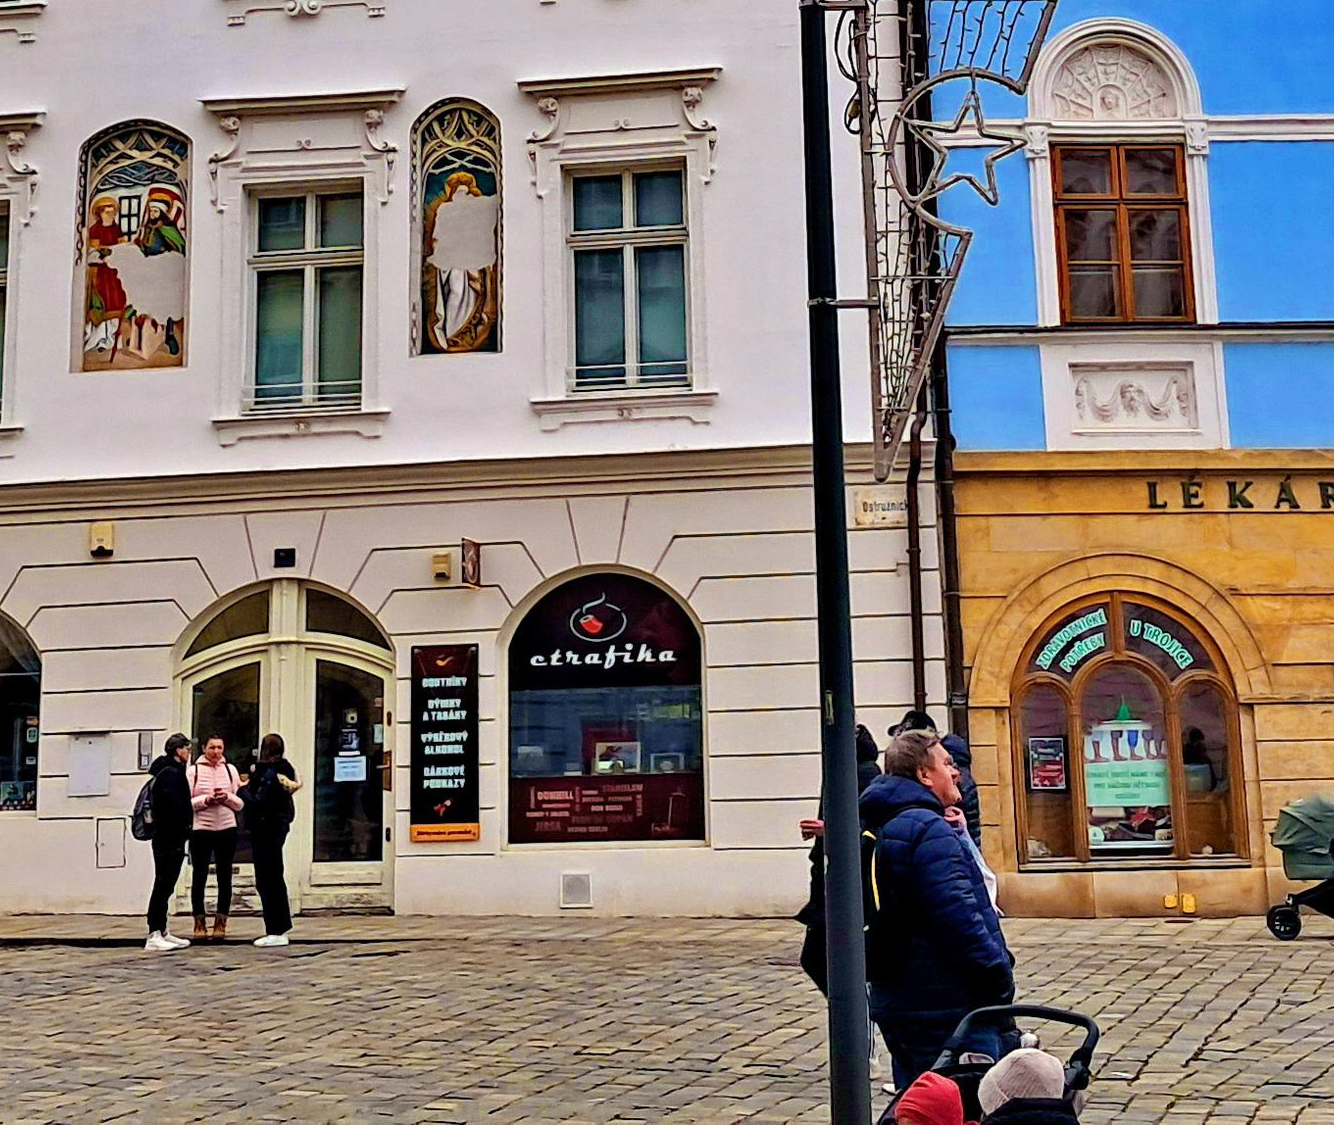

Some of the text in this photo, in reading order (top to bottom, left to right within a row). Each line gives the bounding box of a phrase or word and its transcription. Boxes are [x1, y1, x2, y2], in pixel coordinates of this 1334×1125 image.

[1035, 608, 1108, 670] ZDRAVOTNICKÉ
[1059, 632, 1105, 672] POTŘEBY
[1129, 619, 1194, 669] U TROJICE
